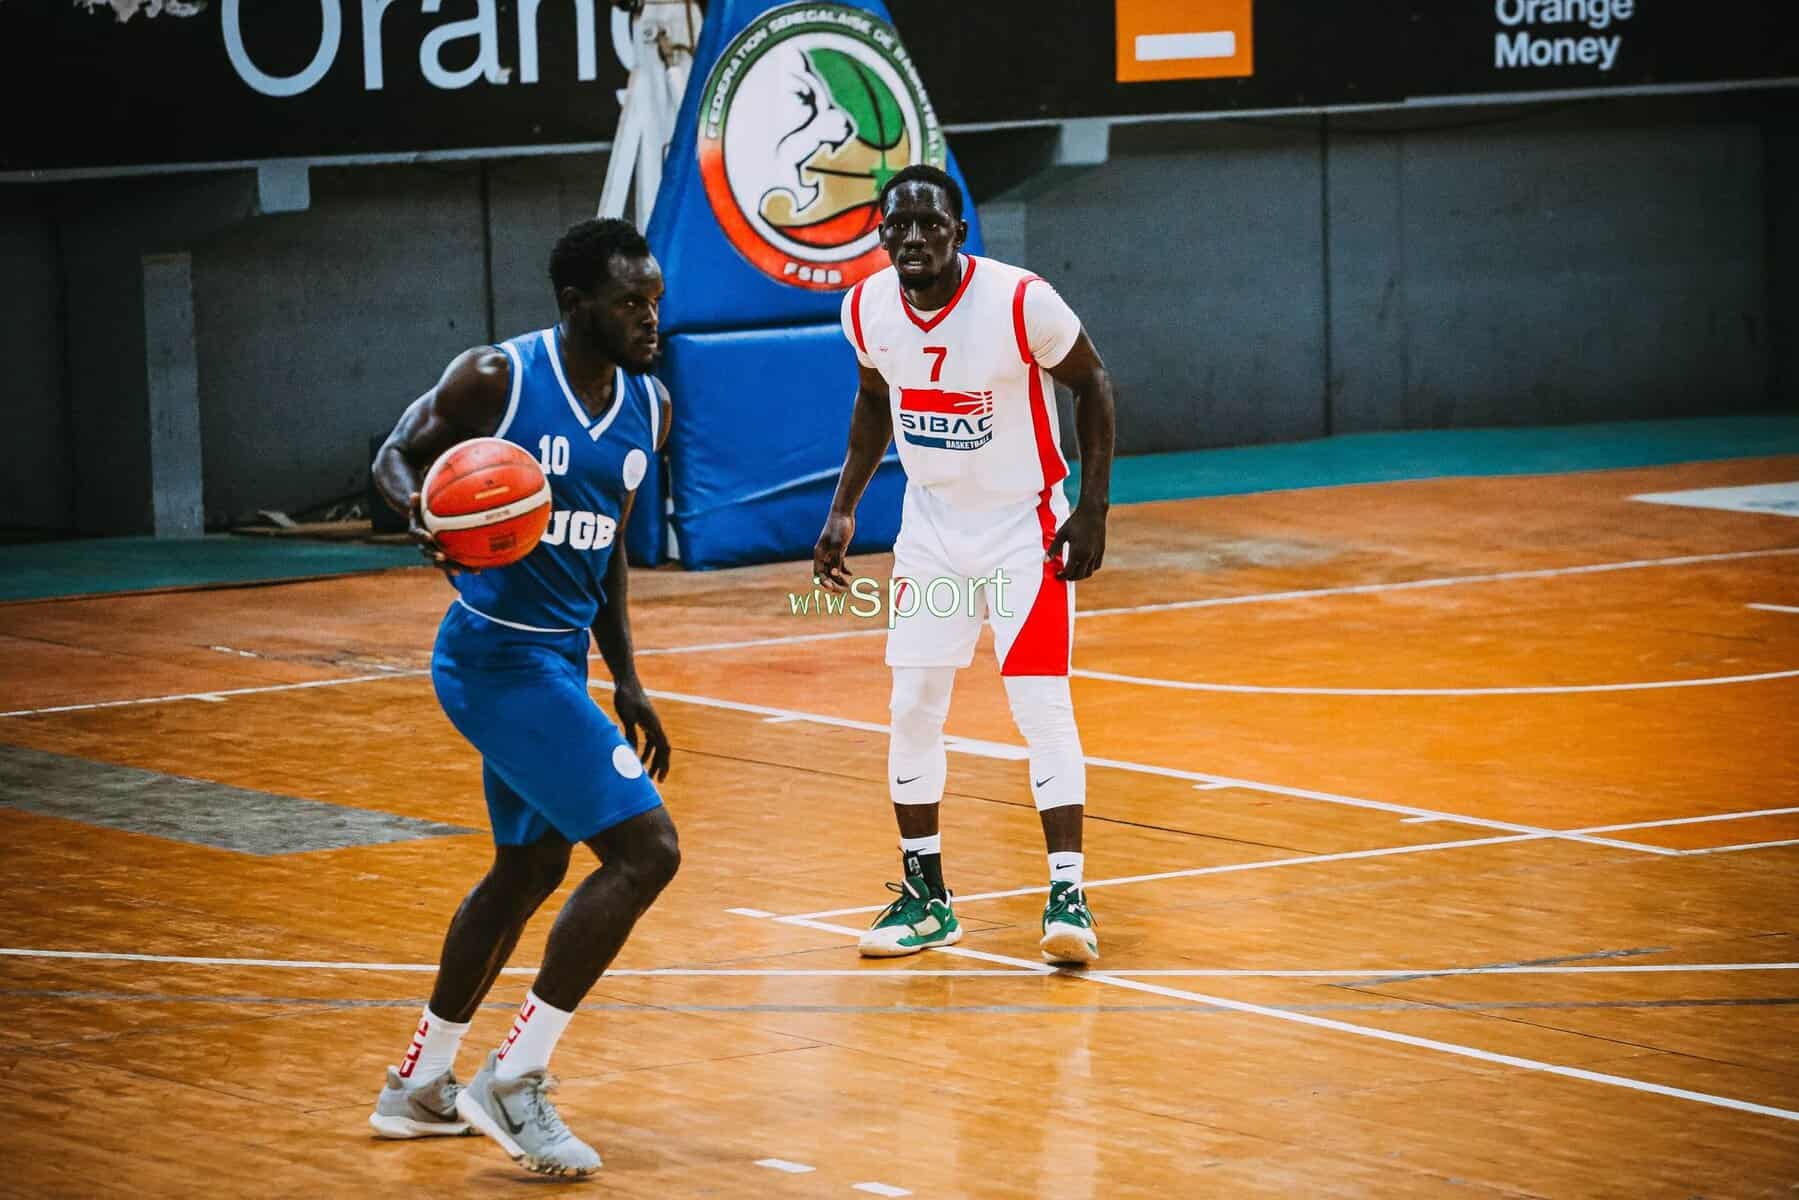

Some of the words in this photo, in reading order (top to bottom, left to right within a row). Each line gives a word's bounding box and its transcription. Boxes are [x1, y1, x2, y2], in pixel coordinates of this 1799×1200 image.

[1495, 0, 1634, 28] Orange
[1494, 31, 1621, 71] Money
[923, 346, 947, 382] 7
[539, 434, 569, 476] 10
[541, 510, 616, 550] UGB
